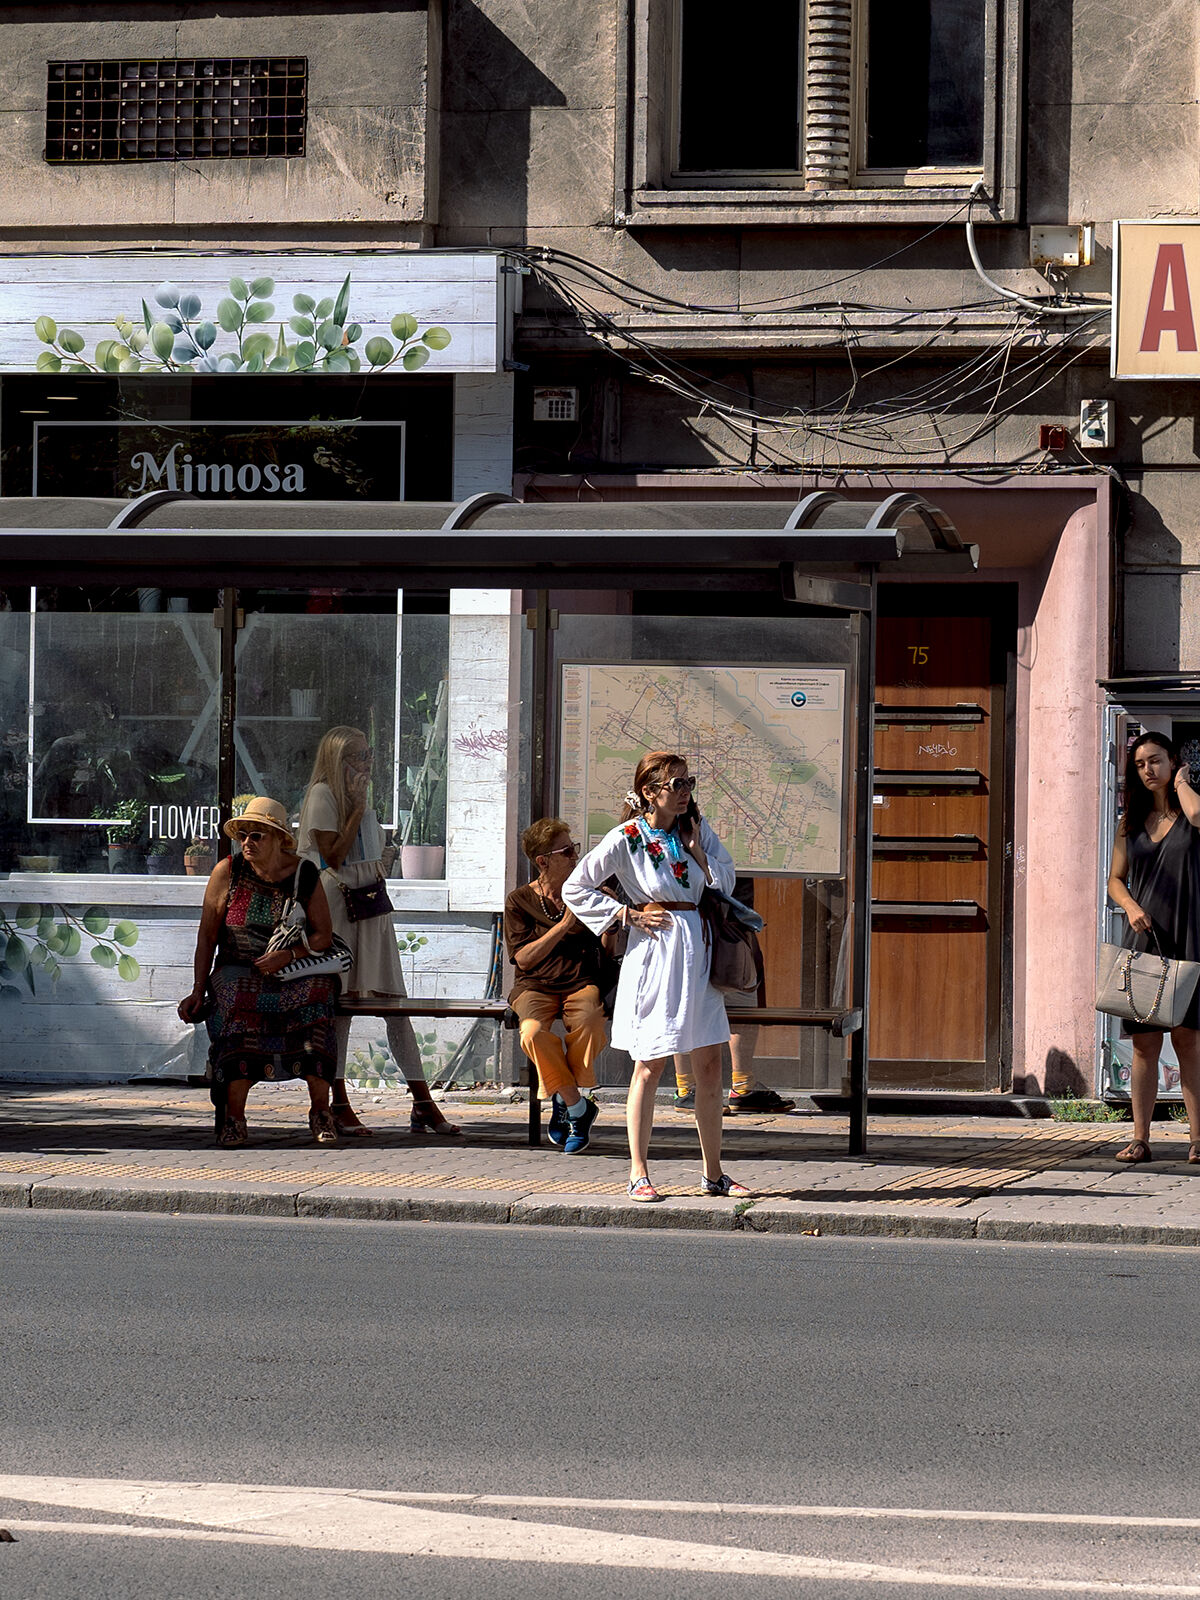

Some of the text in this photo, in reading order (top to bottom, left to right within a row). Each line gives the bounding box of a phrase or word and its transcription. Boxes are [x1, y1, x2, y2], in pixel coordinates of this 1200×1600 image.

[127, 442, 306, 493] Mimosa
[908, 646, 930, 665] 75
[149, 805, 221, 840] FLOWER
